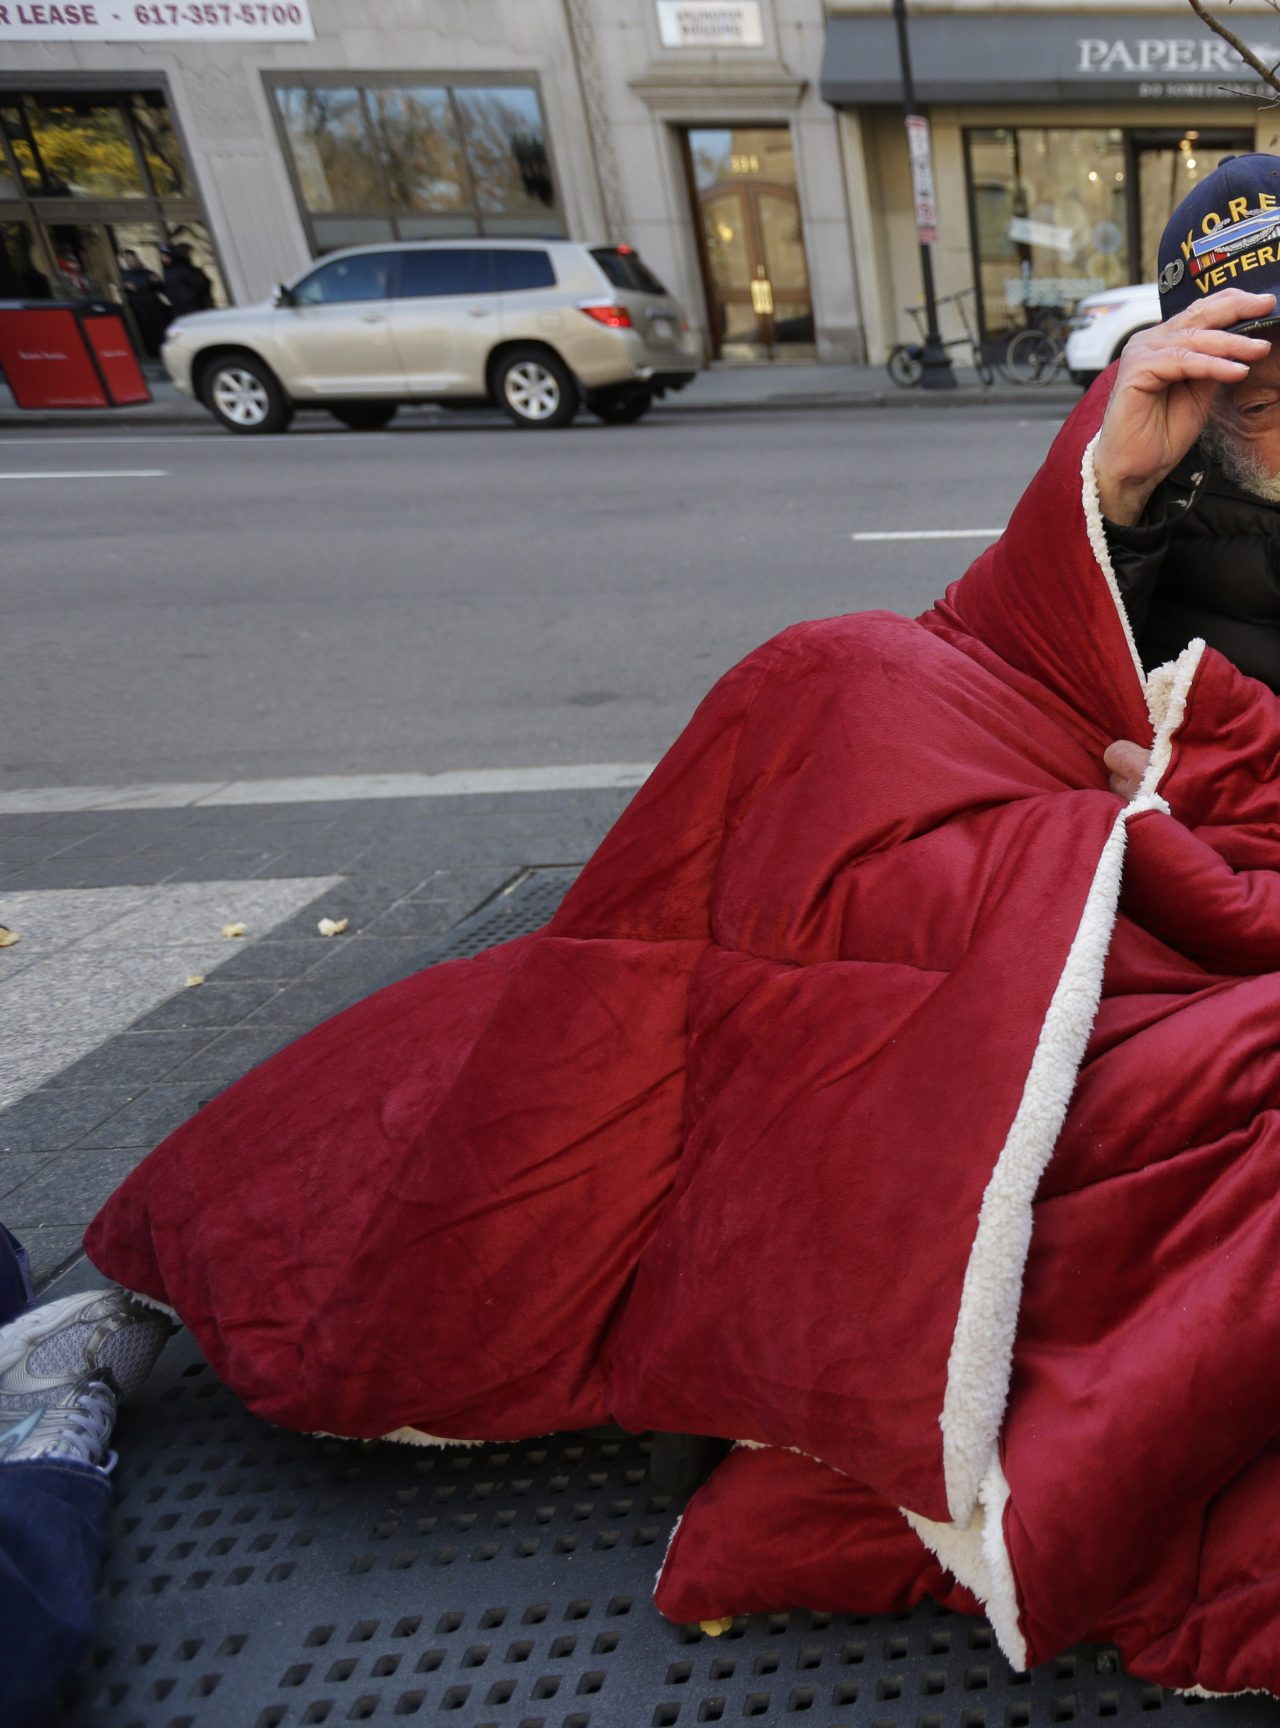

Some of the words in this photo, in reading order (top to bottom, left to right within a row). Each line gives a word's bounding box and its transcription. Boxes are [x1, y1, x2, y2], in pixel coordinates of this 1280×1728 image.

[19, 5, 98, 25] LEASE
[134, 4, 302, 25] 617-357-5700
[1078, 39, 1233, 73] PAPER
